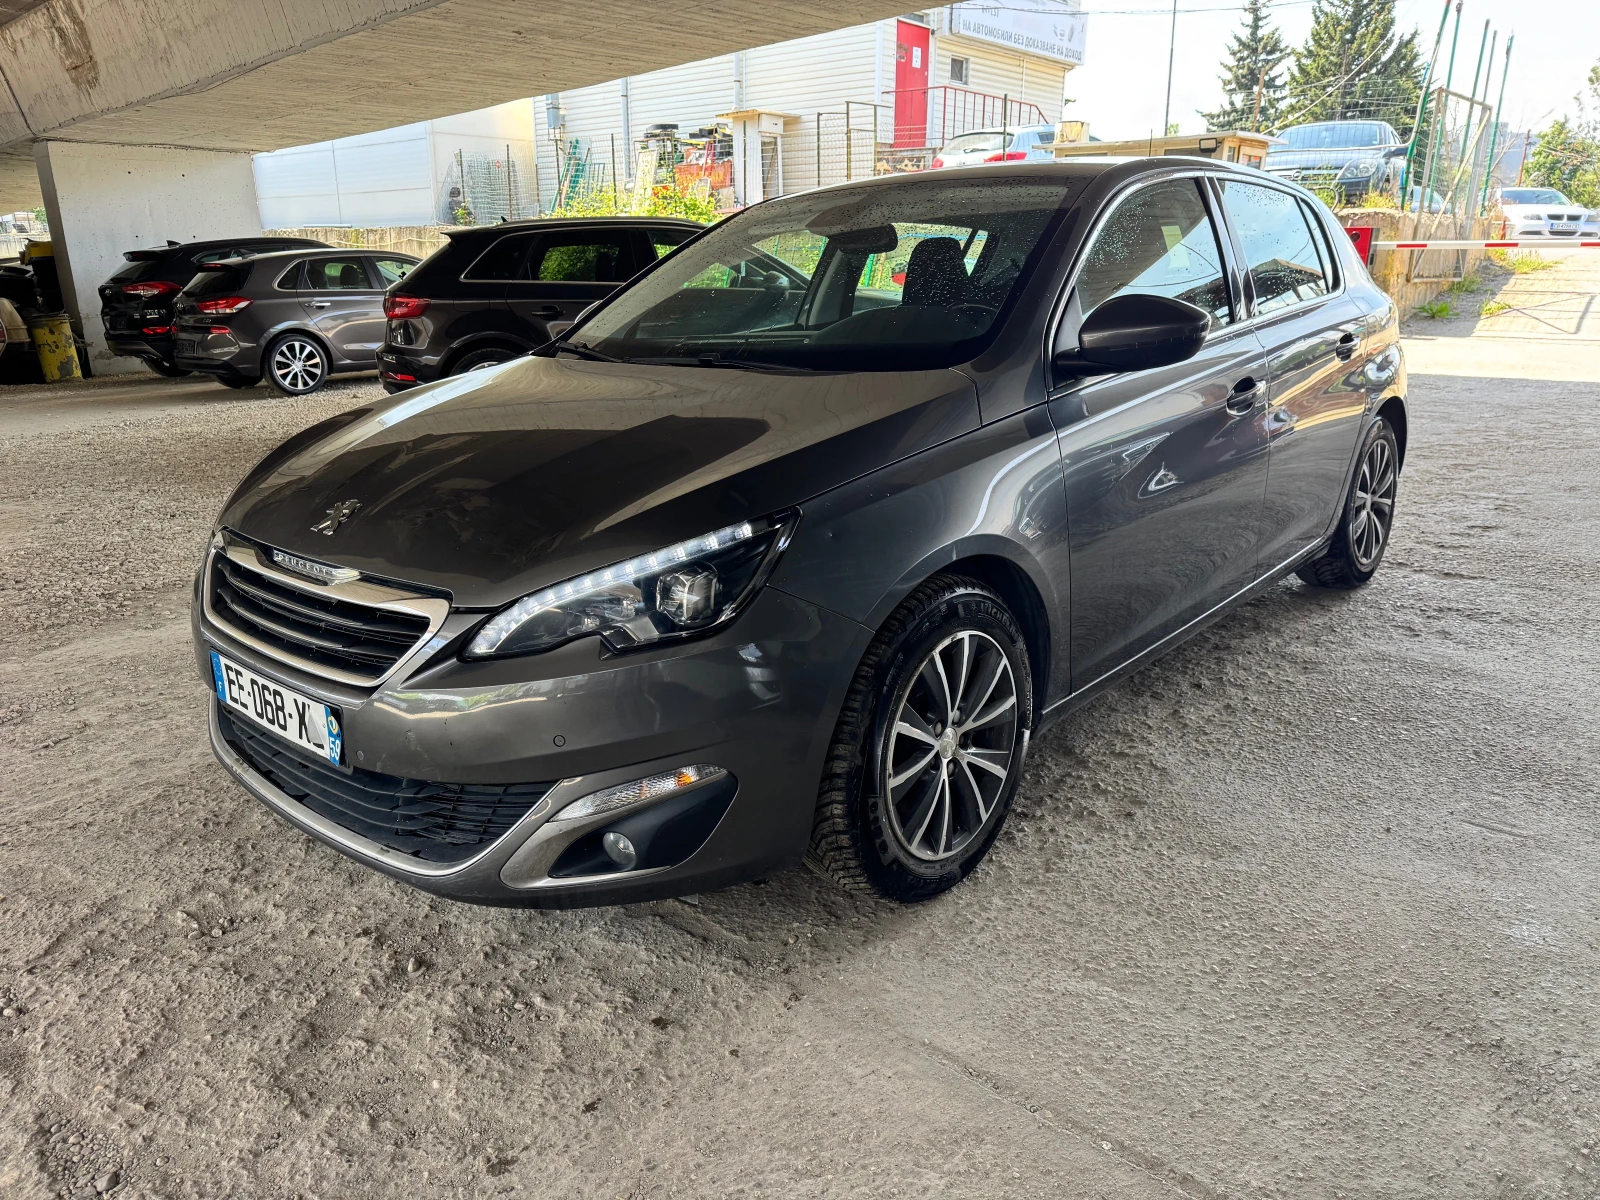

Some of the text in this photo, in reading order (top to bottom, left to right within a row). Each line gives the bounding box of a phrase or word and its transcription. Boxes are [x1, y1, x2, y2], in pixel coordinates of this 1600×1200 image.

[962, 19, 1082, 62] НА АВТОМОБИЛИ БЕЗ ДОКАЗВАНЕ НА ДОХОД
[278, 553, 329, 576] PEUGEOT
[223, 662, 325, 751] EE-068-X
[329, 736, 341, 760] 59
